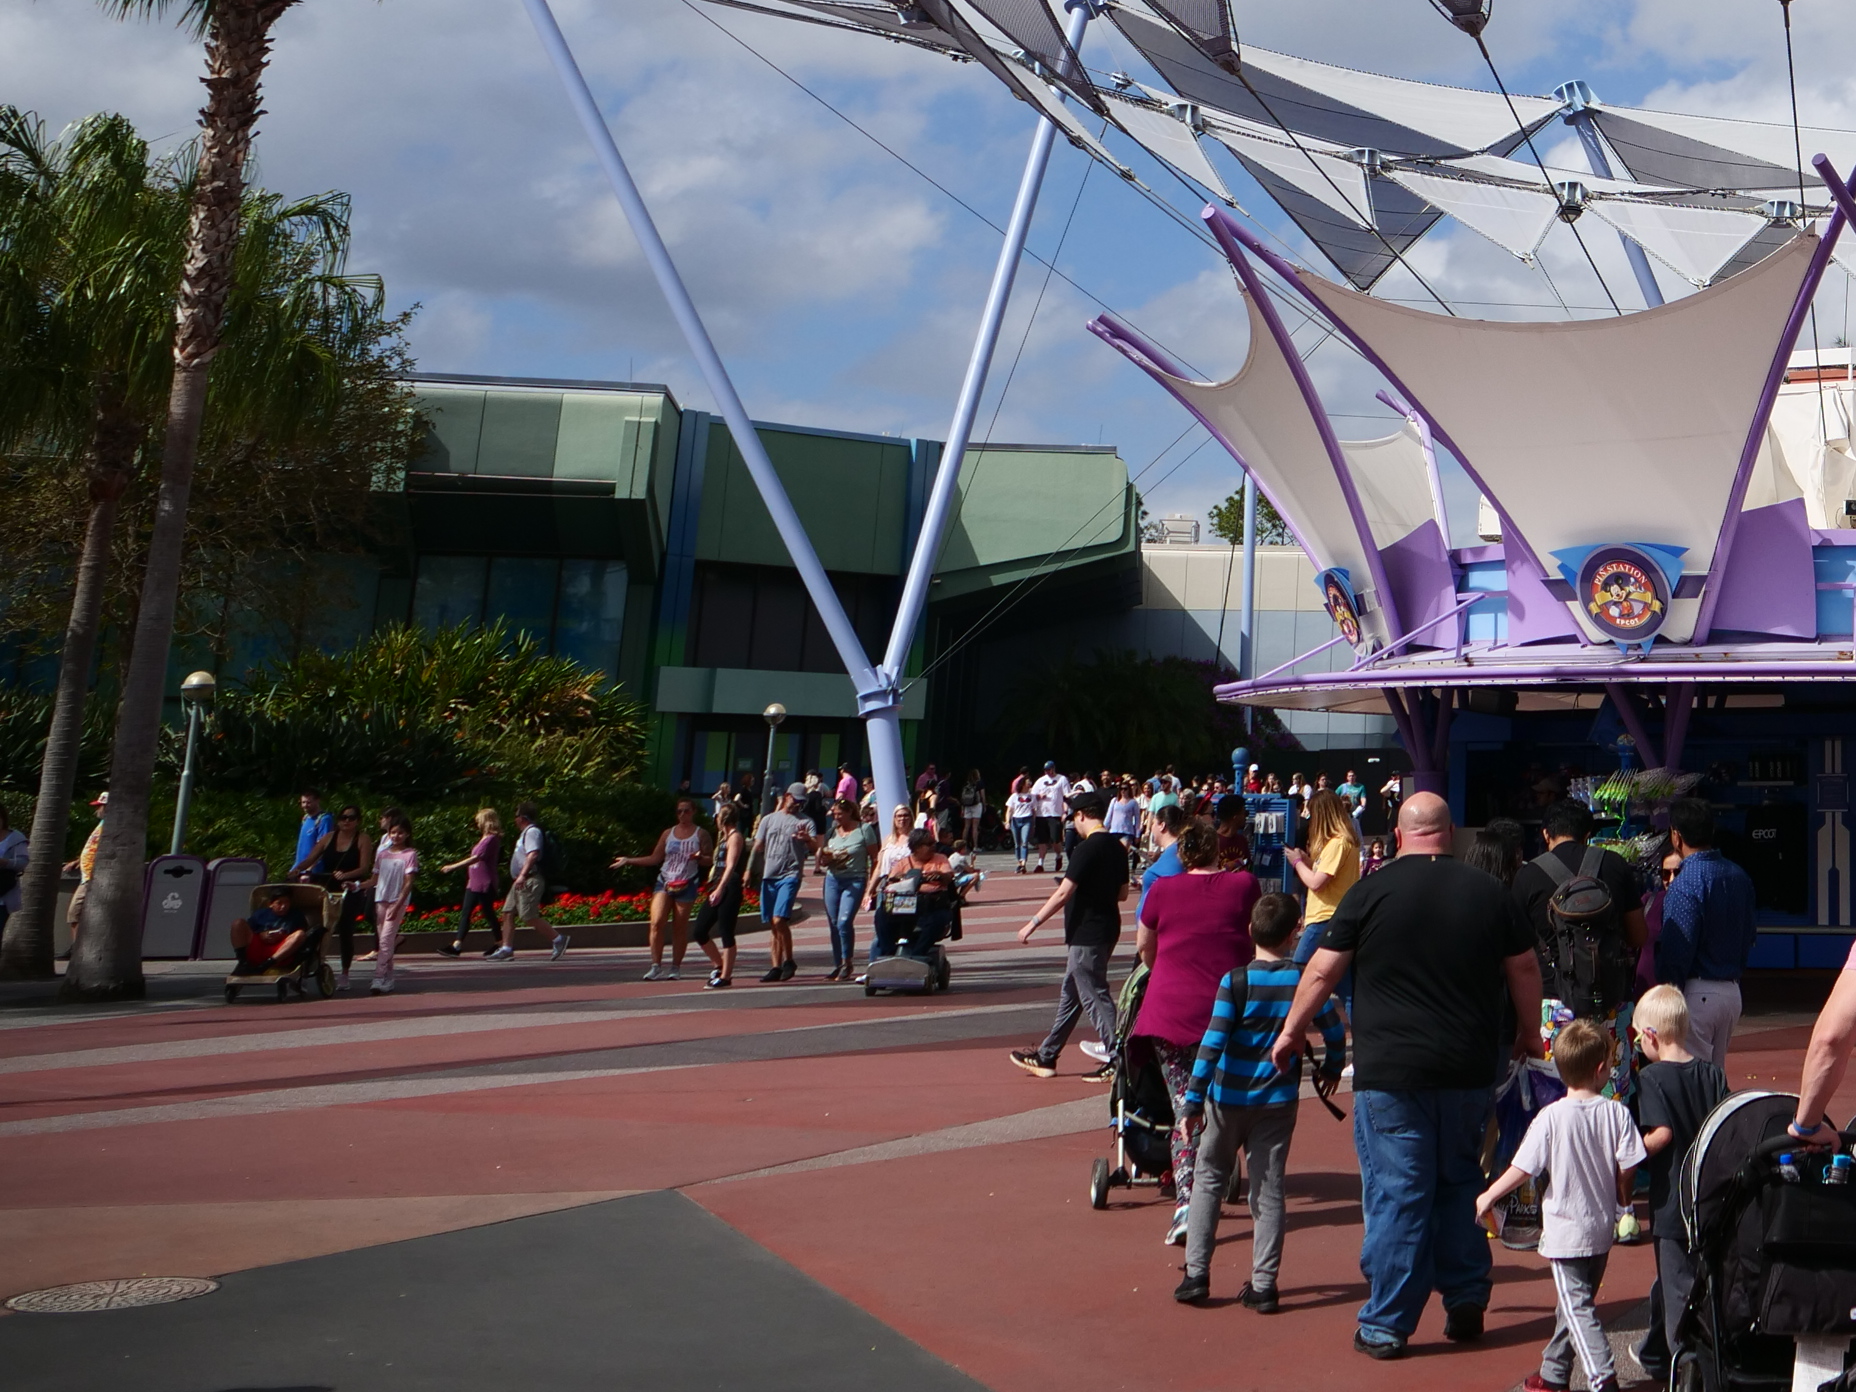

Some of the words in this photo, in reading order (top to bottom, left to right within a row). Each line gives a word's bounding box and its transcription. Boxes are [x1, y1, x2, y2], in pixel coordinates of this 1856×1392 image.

[1594, 568, 1607, 585] PIN
[1607, 563, 1648, 584] STATION
[1616, 617, 1639, 625] EPCOT
[1752, 829, 1777, 839] EPCOT
